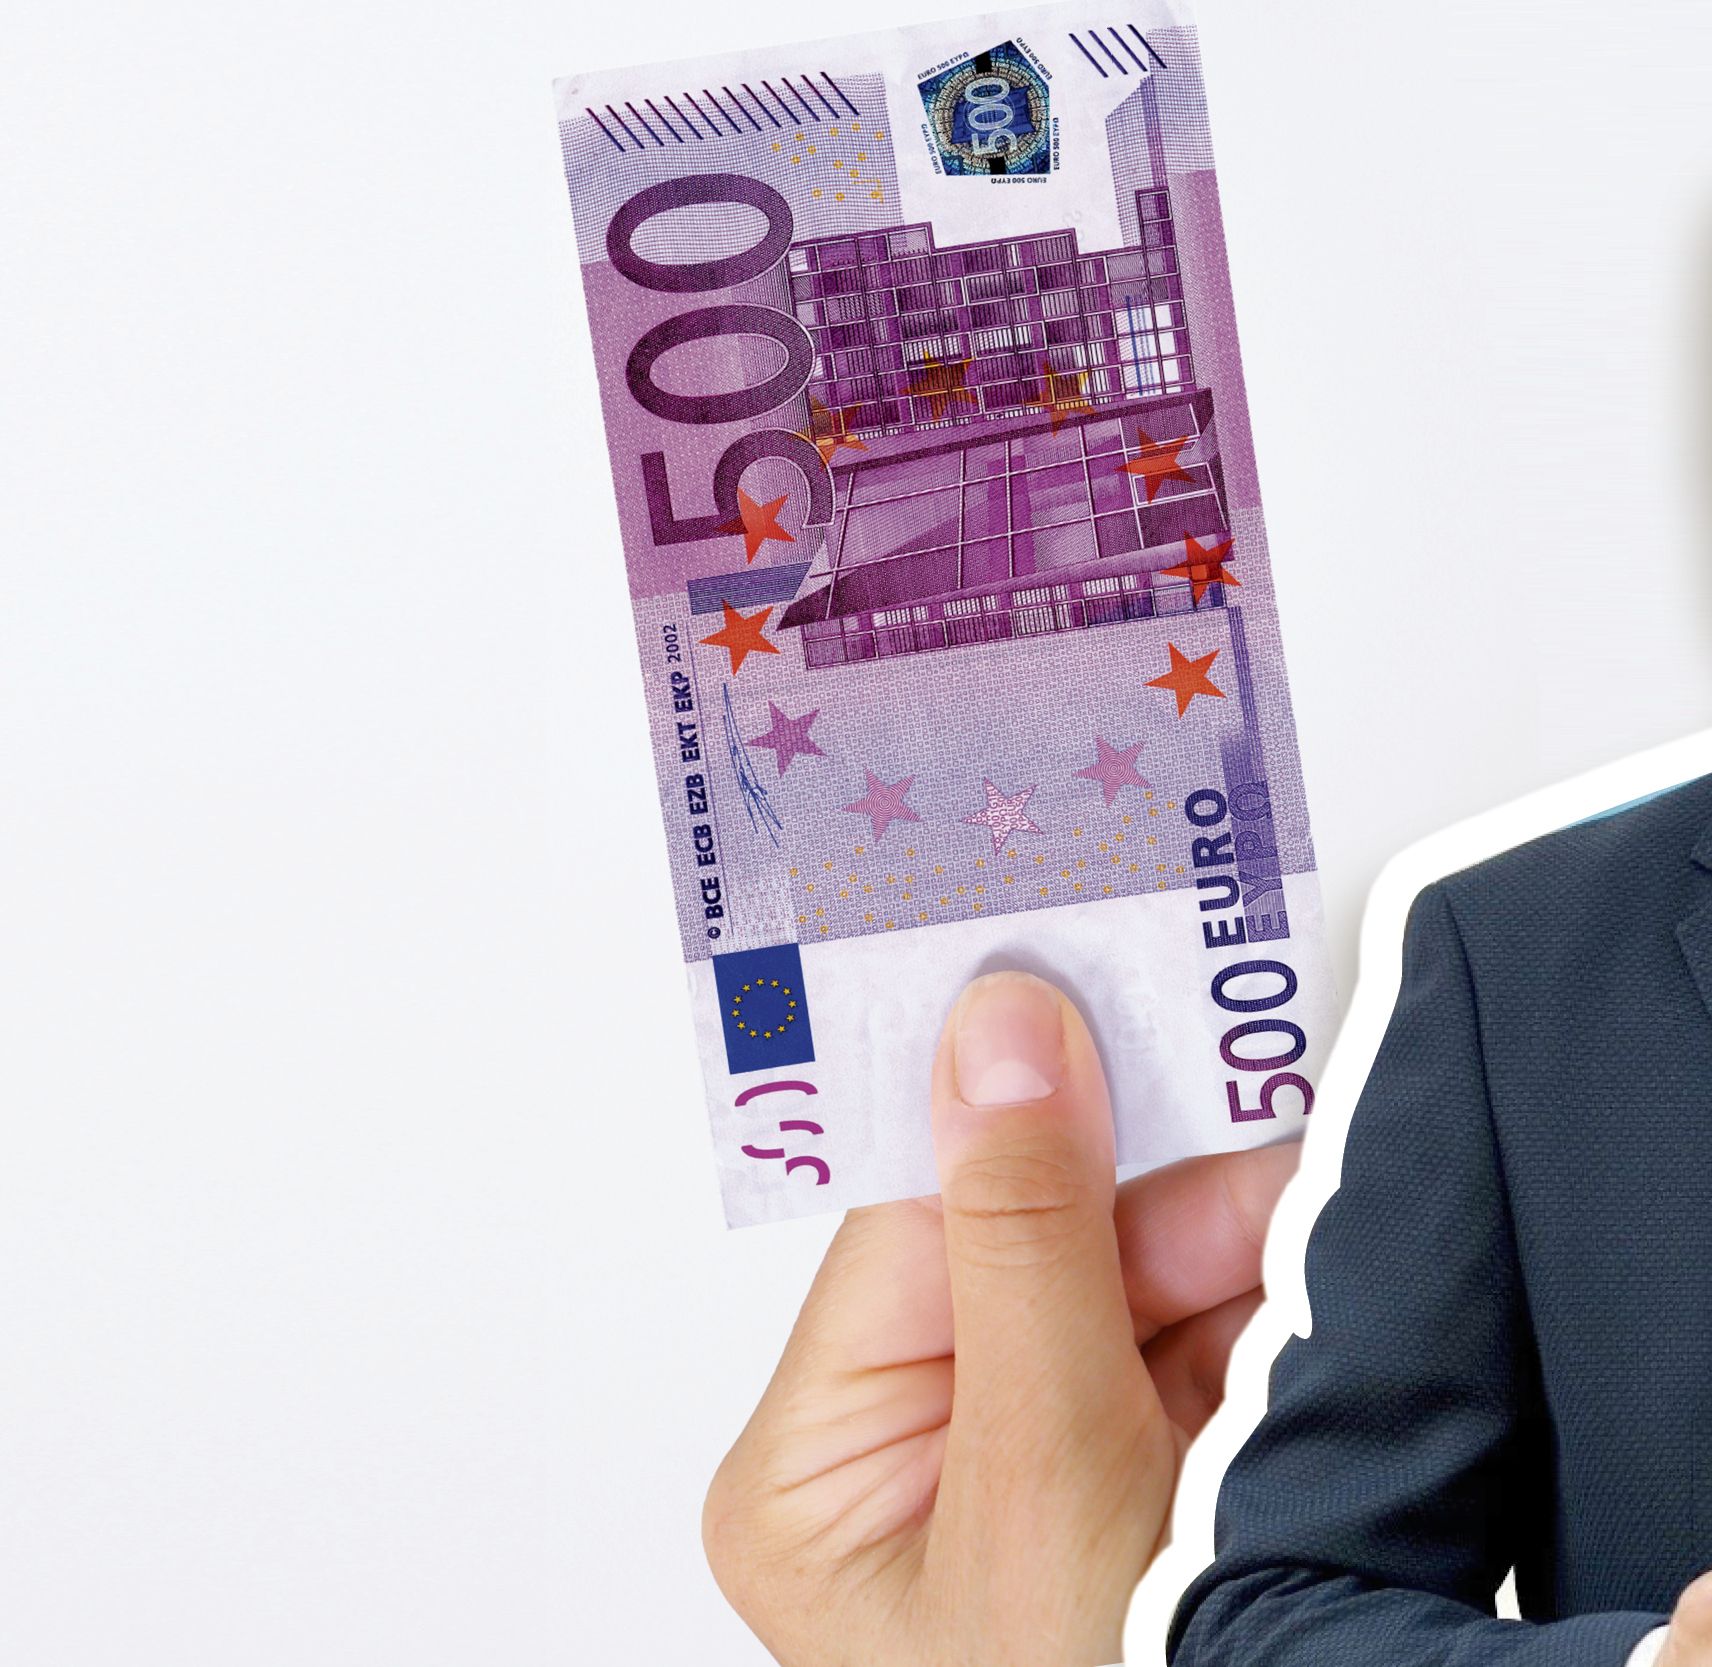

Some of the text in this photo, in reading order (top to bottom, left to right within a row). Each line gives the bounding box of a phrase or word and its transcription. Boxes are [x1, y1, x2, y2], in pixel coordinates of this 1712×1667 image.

[964, 77, 1018, 155] 500
[606, 173, 836, 547] 500
[663, 623, 681, 663] 2002
[671, 671, 694, 713] EKP
[677, 722, 700, 763] EKT
[685, 773, 708, 815] EZB
[693, 823, 716, 867] ECB
[700, 876, 724, 919] BCE
[1185, 789, 1315, 1123] 500 EURO
